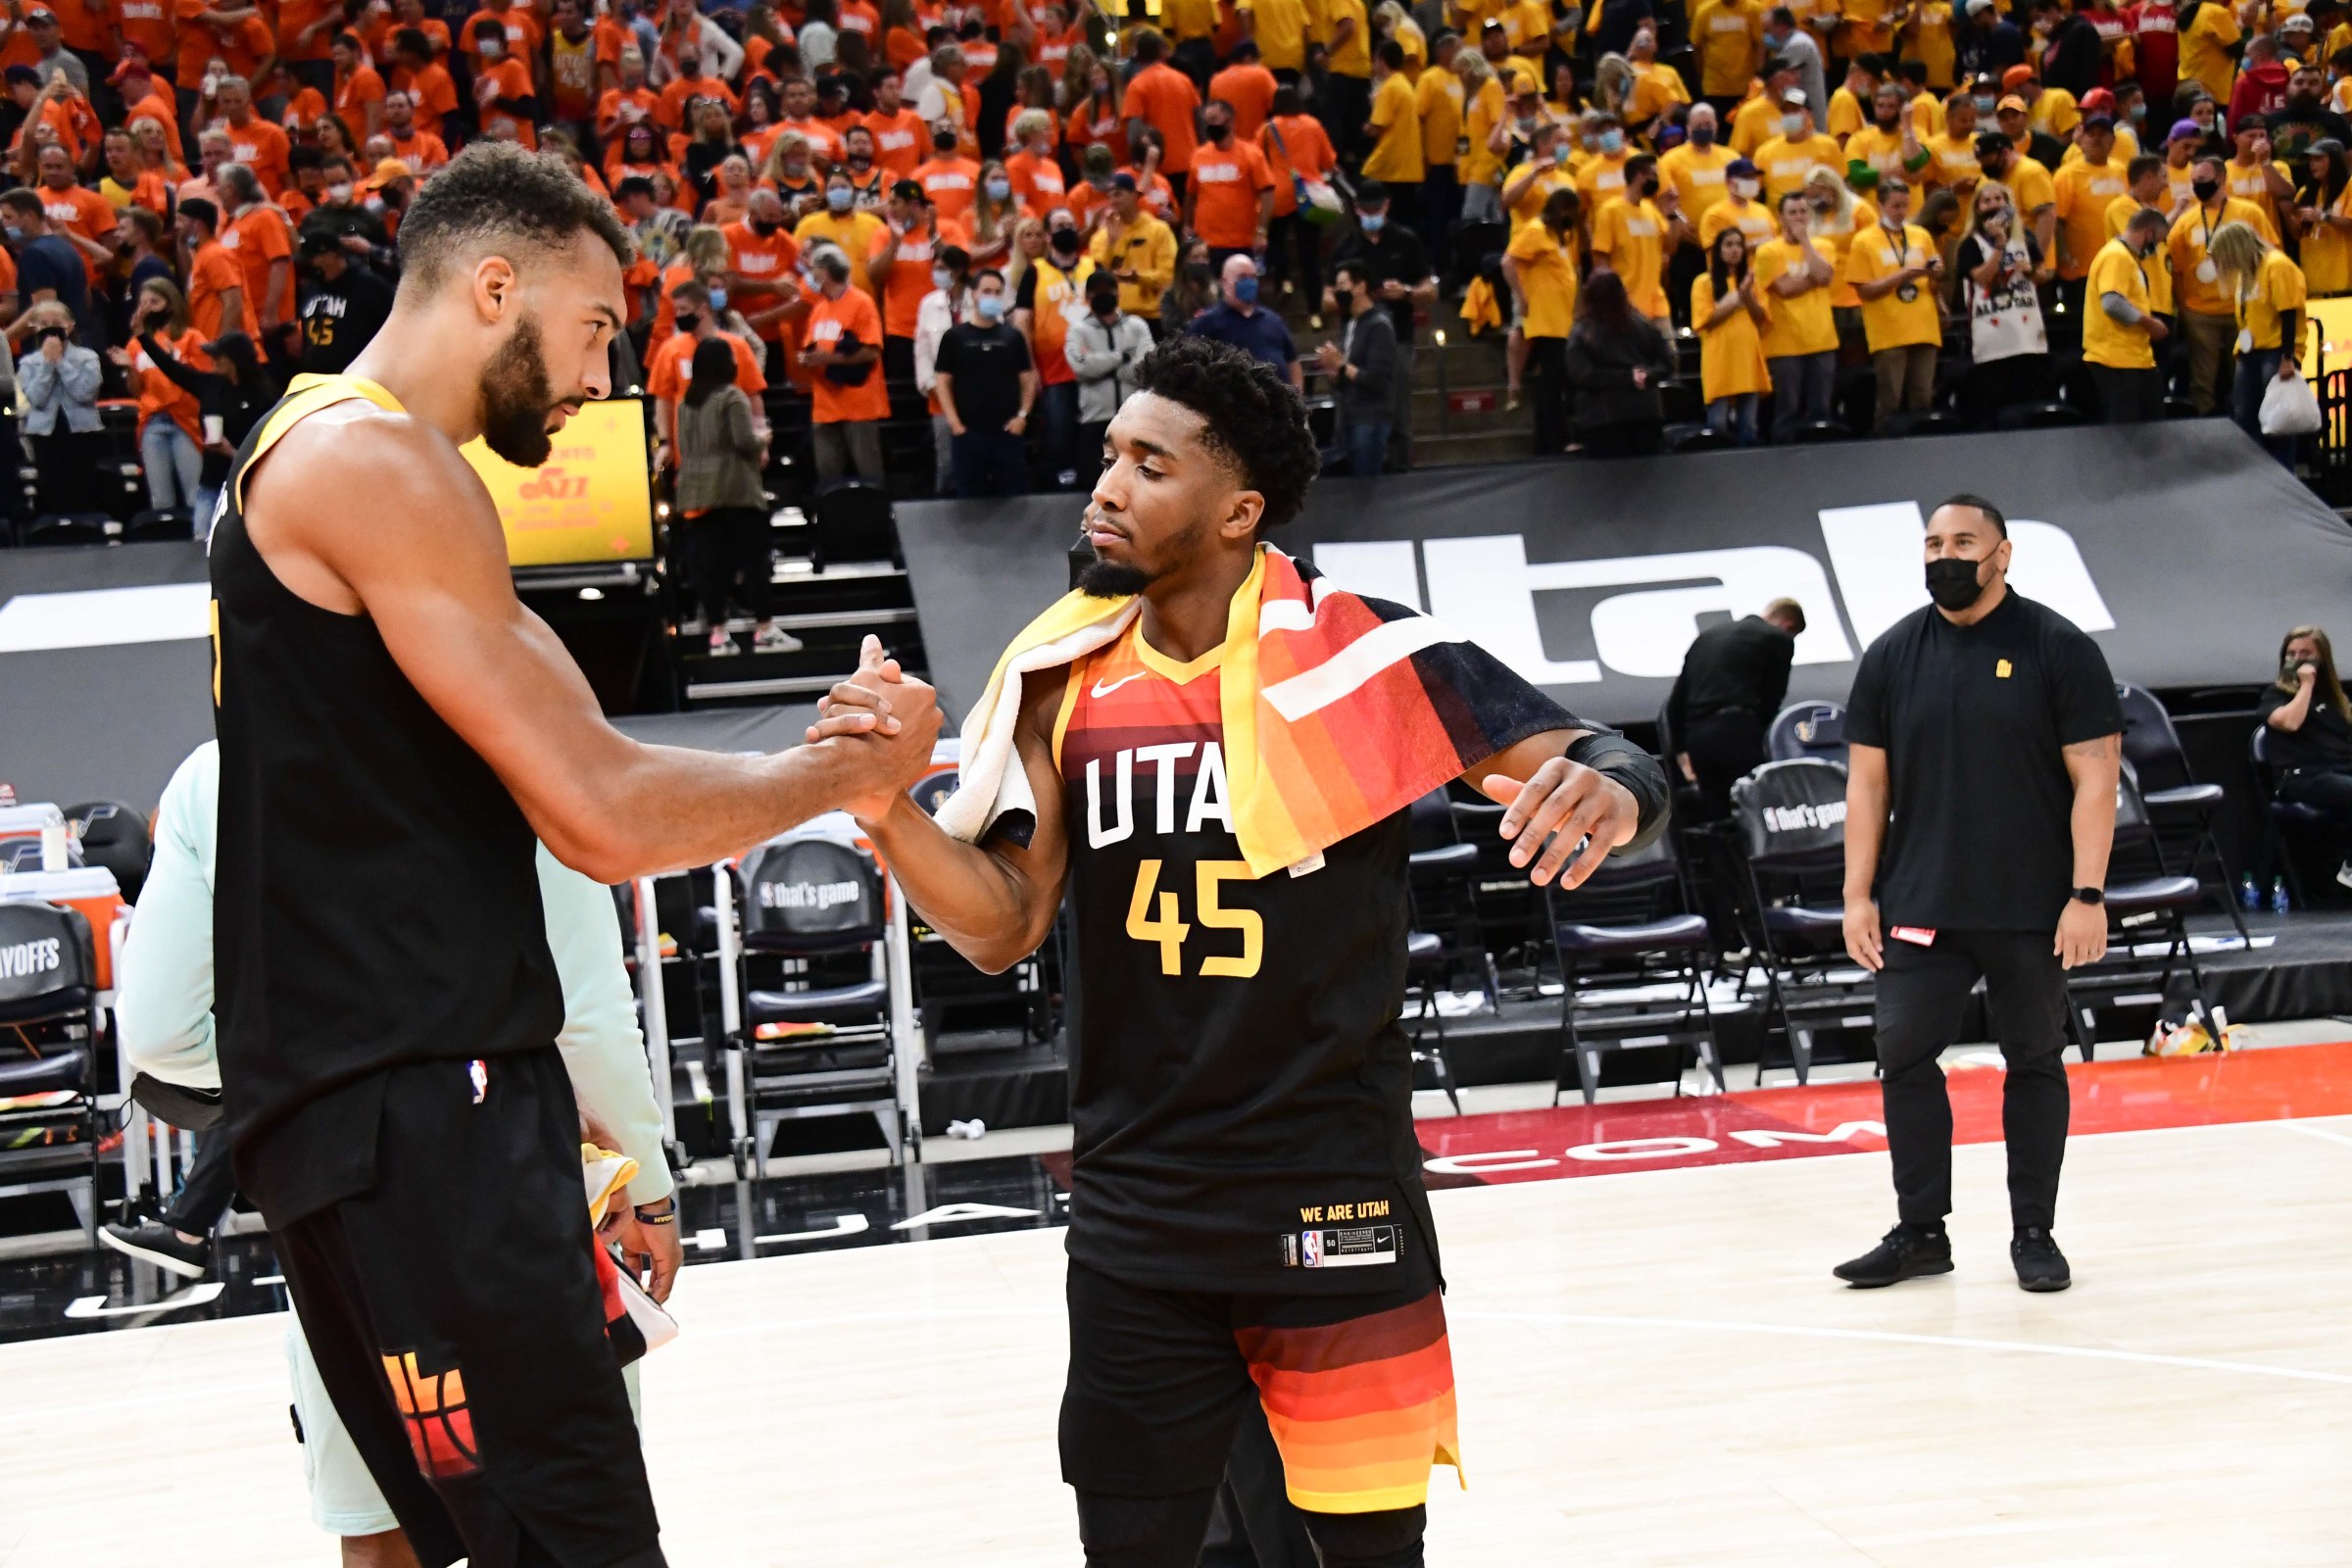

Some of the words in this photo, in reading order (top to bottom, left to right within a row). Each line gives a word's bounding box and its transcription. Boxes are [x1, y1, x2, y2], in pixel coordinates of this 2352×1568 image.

[308, 318, 334, 346] 45
[1086, 741, 1237, 851] UTA
[1776, 804, 1818, 831] that's
[1816, 800, 1847, 830] gam
[774, 881, 816, 908] that's
[817, 880, 859, 910] game
[1125, 858, 1264, 979] 45
[1299, 1206, 1324, 1223] WE
[1326, 1203, 1354, 1221] ARE
[1356, 1200, 1390, 1219] UTAH
[1326, 1239, 1336, 1248] 50
